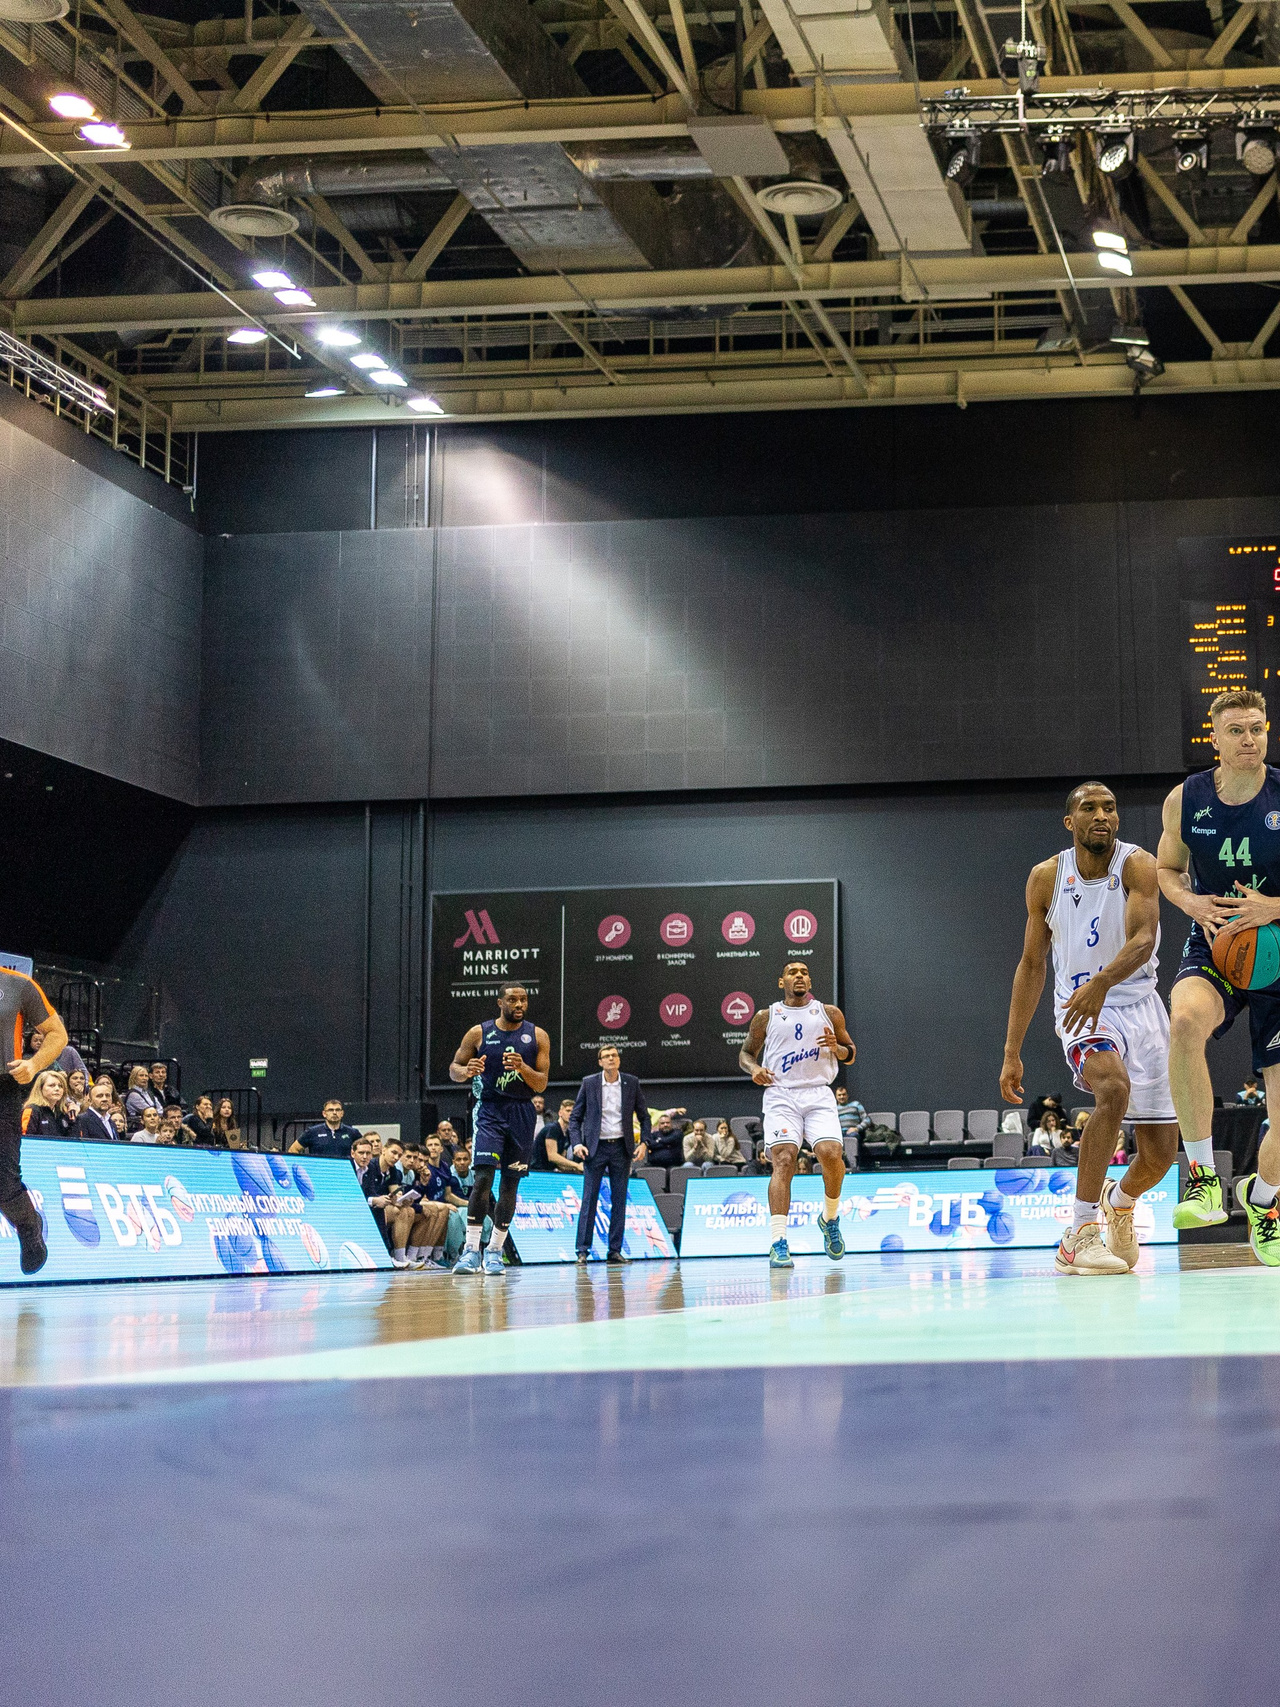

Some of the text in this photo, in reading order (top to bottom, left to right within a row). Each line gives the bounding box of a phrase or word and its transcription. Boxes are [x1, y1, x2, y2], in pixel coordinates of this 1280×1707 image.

[1267, 615, 1274, 626] 3
[1192, 826, 1216, 836] Kempa
[1218, 837, 1252, 867] 44
[463, 948, 539, 961] MARRIOTT
[463, 964, 508, 976] MINSK
[665, 1004, 687, 1016] VIP
[794, 1023, 802, 1040] 8
[782, 1046, 820, 1073] Enisey
[185, 1190, 305, 1214] ТИТУЛЬНЫЙ СПОНСОР
[694, 1202, 770, 1216] ТИТУЛЬНЫ
[908, 1192, 987, 1227] ВТБ
[94, 1183, 183, 1246] ВТБ
[705, 1213, 764, 1230] ЕДИНОЙ
[206, 1214, 258, 1240] ЕДИНОЙ
[255, 1218, 288, 1236] ЛИГИ
